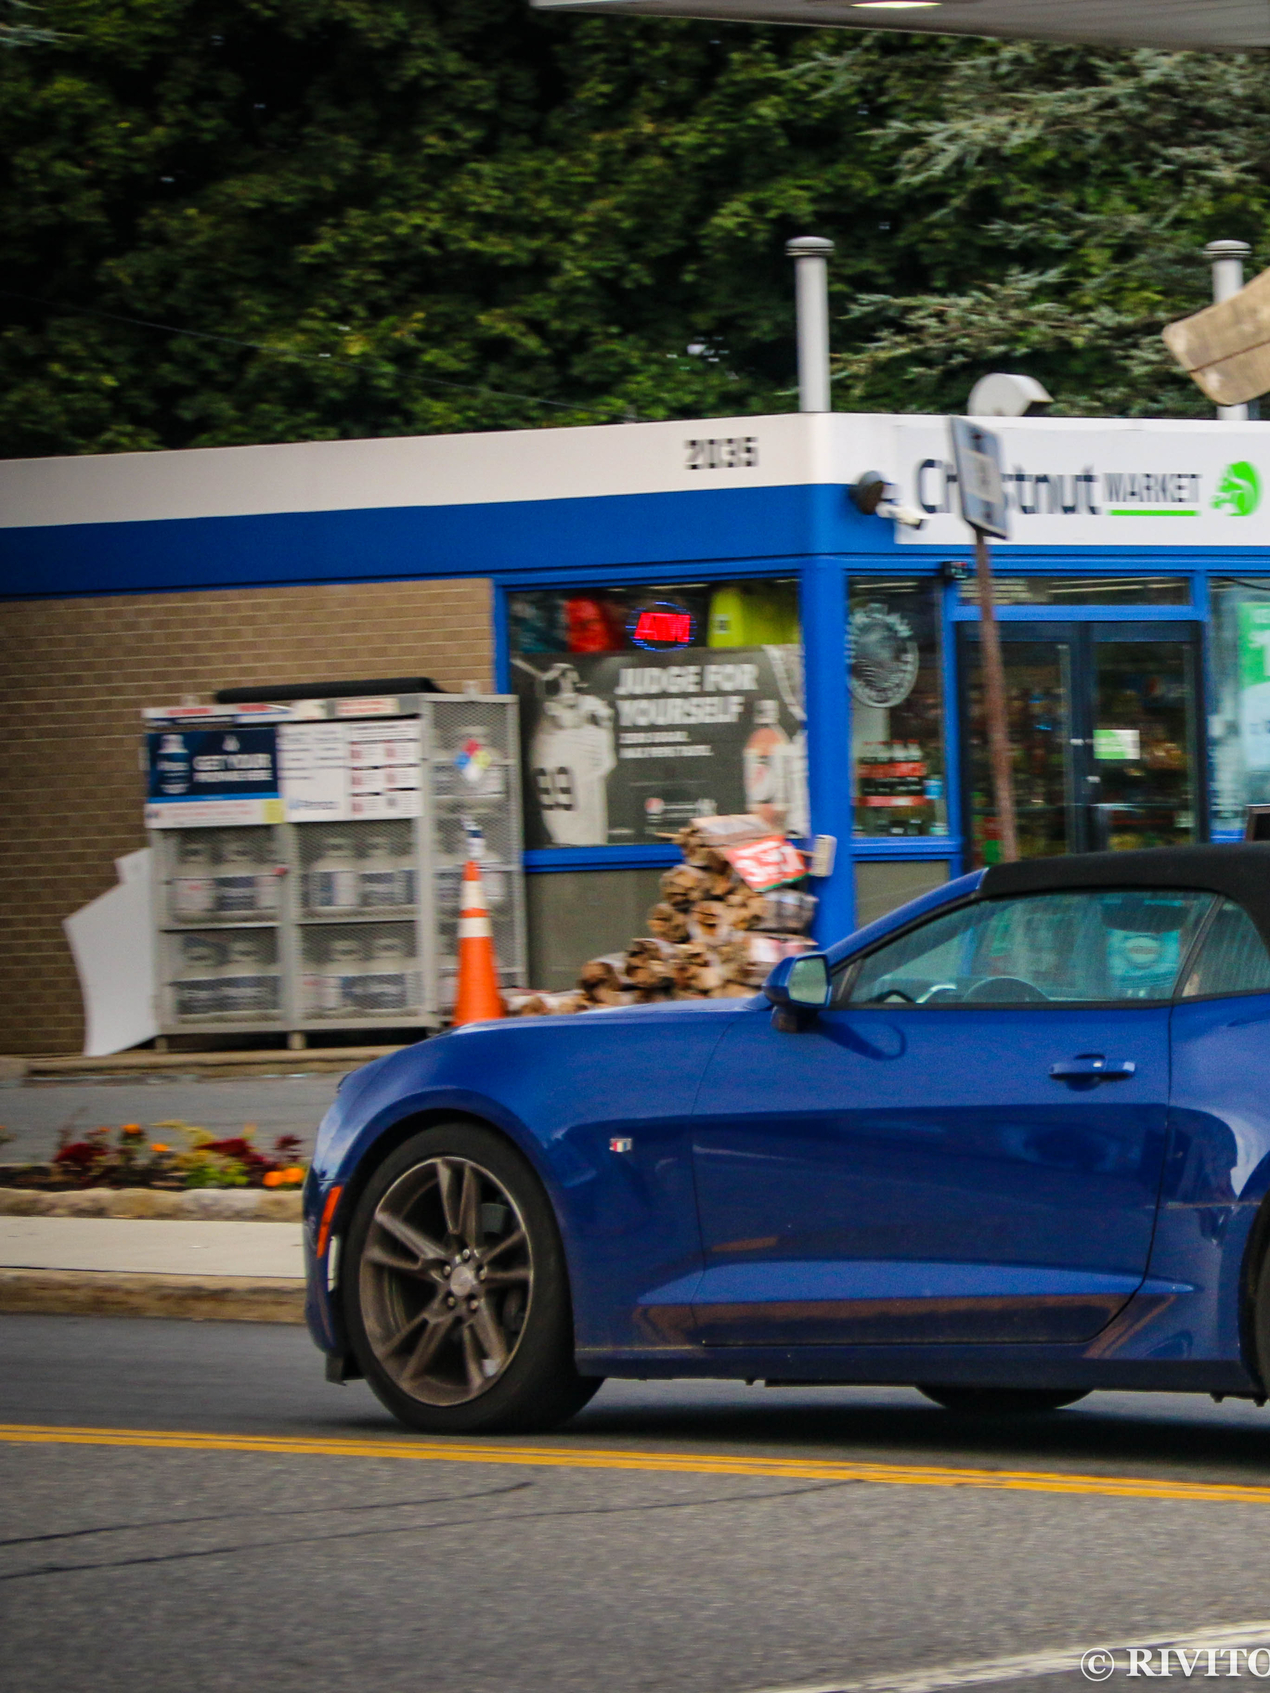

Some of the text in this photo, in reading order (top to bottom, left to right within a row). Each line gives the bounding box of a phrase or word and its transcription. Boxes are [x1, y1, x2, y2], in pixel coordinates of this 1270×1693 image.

[683, 436, 759, 470] 2035
[1102, 473, 1203, 503] MARKET
[613, 663, 759, 695] JUDGE FOR
[614, 695, 746, 727] YOURSELF
